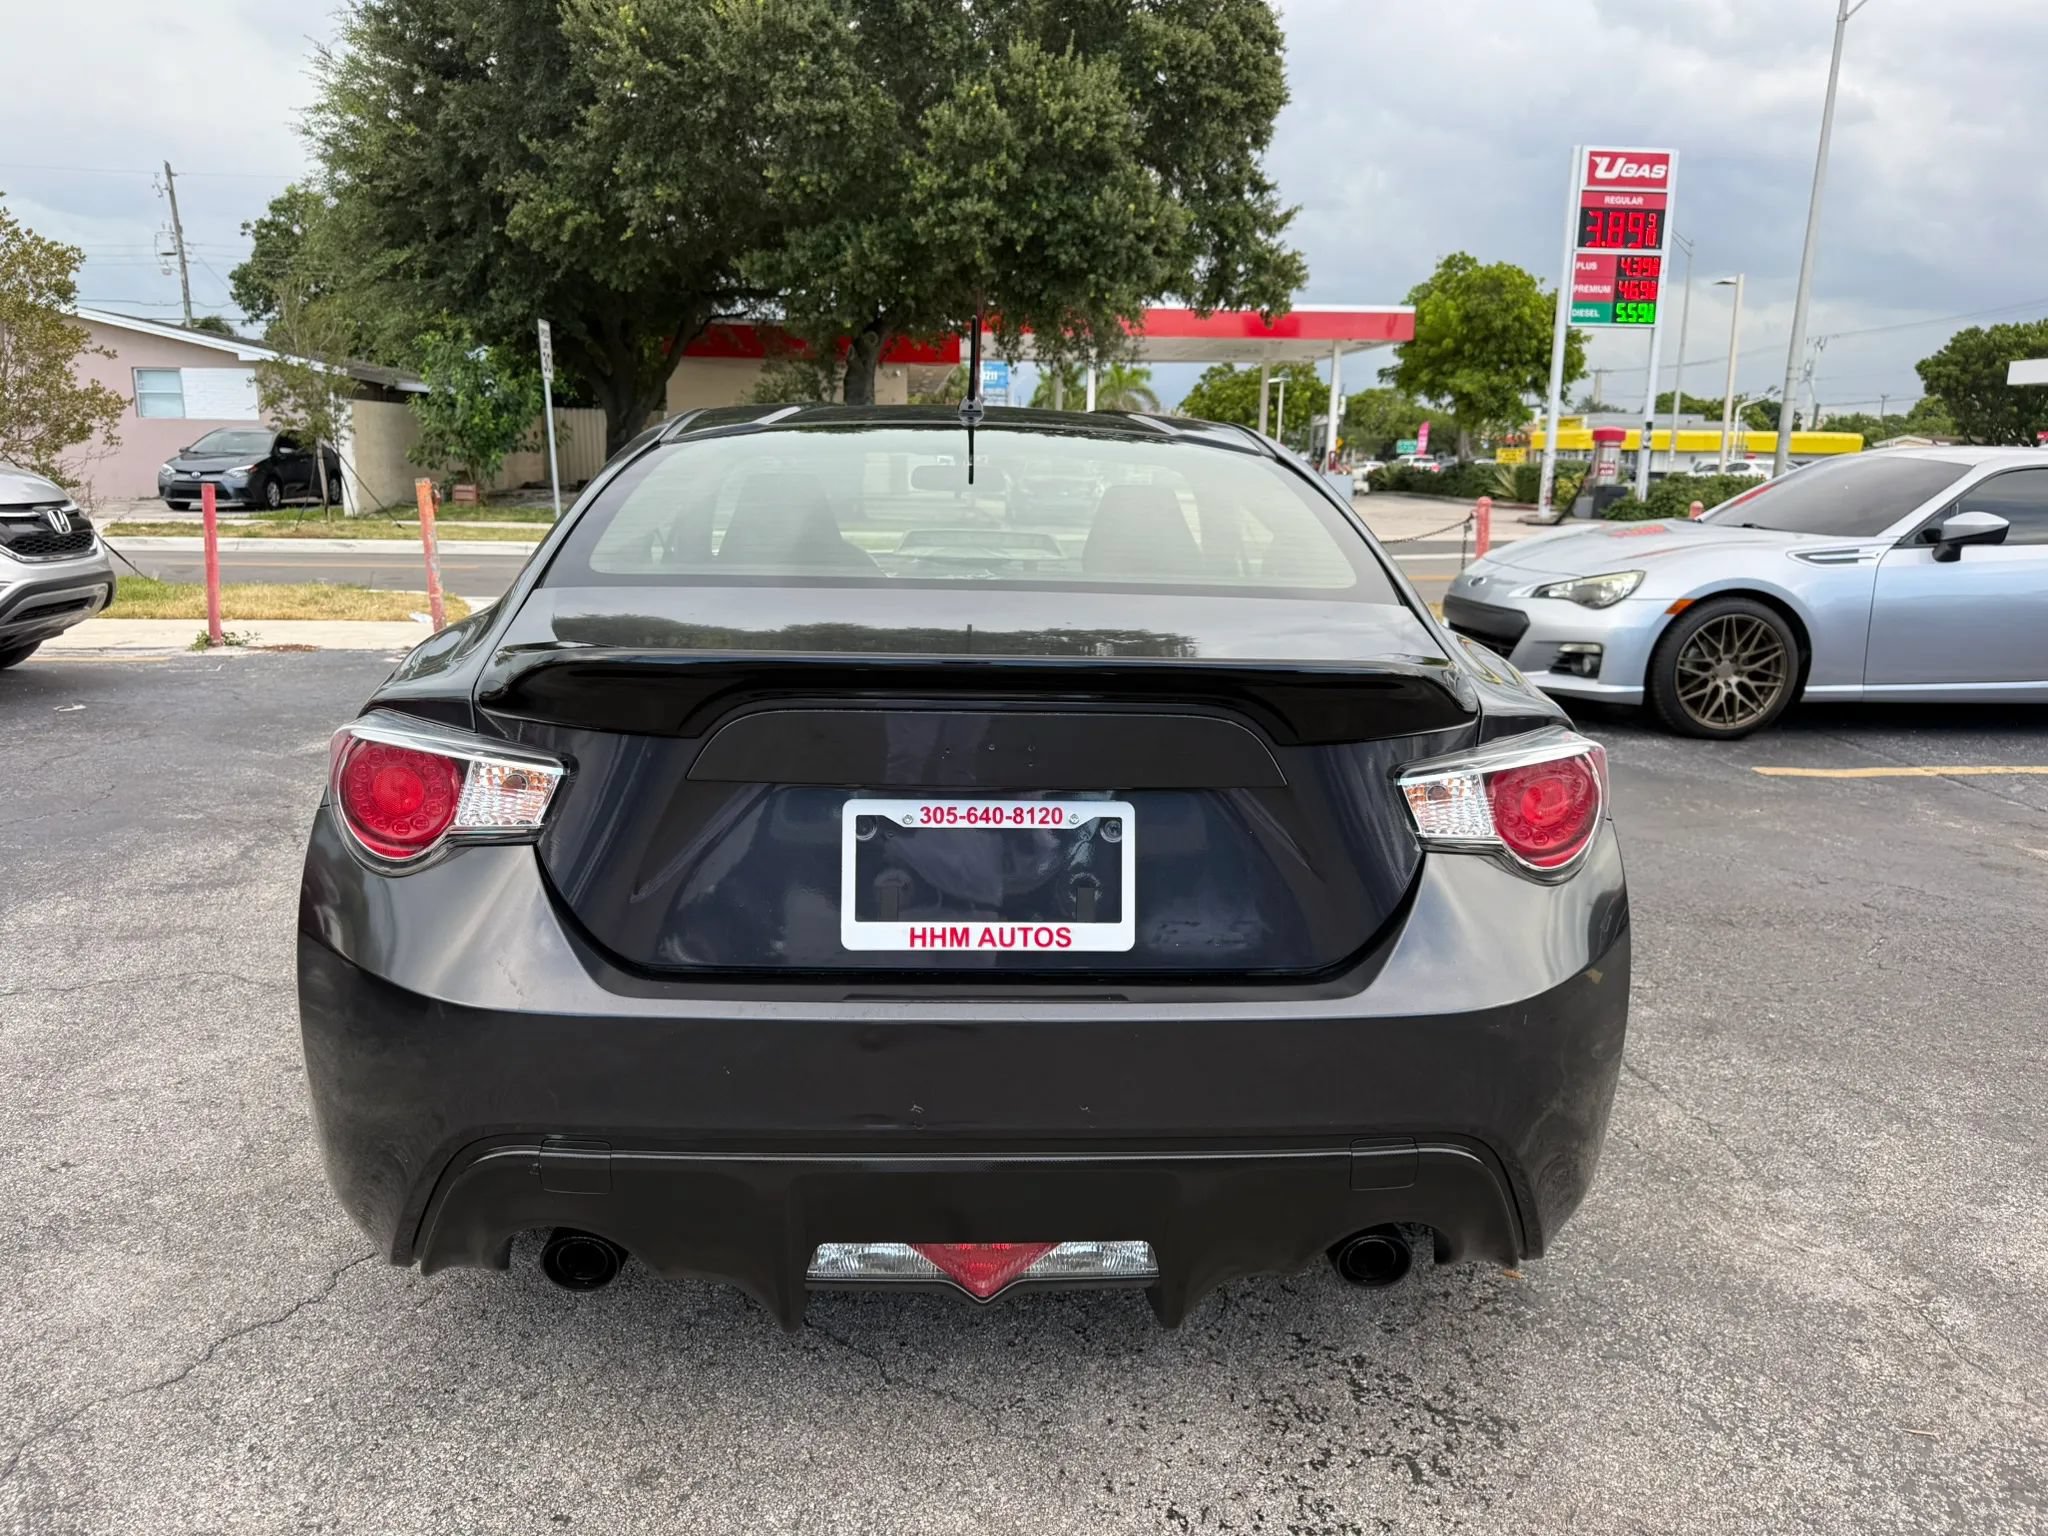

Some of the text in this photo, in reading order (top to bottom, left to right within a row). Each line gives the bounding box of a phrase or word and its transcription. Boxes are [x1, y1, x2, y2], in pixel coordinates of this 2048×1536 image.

[1603, 195, 1644, 206] REGULAR
[1575, 261, 1598, 271] PLUS
[1572, 284, 1612, 294] PREMIUM
[1571, 308, 1600, 318] DIESEL
[919, 806, 1064, 825] 305-640-8120
[909, 927, 1072, 948] HHM AUTOS
